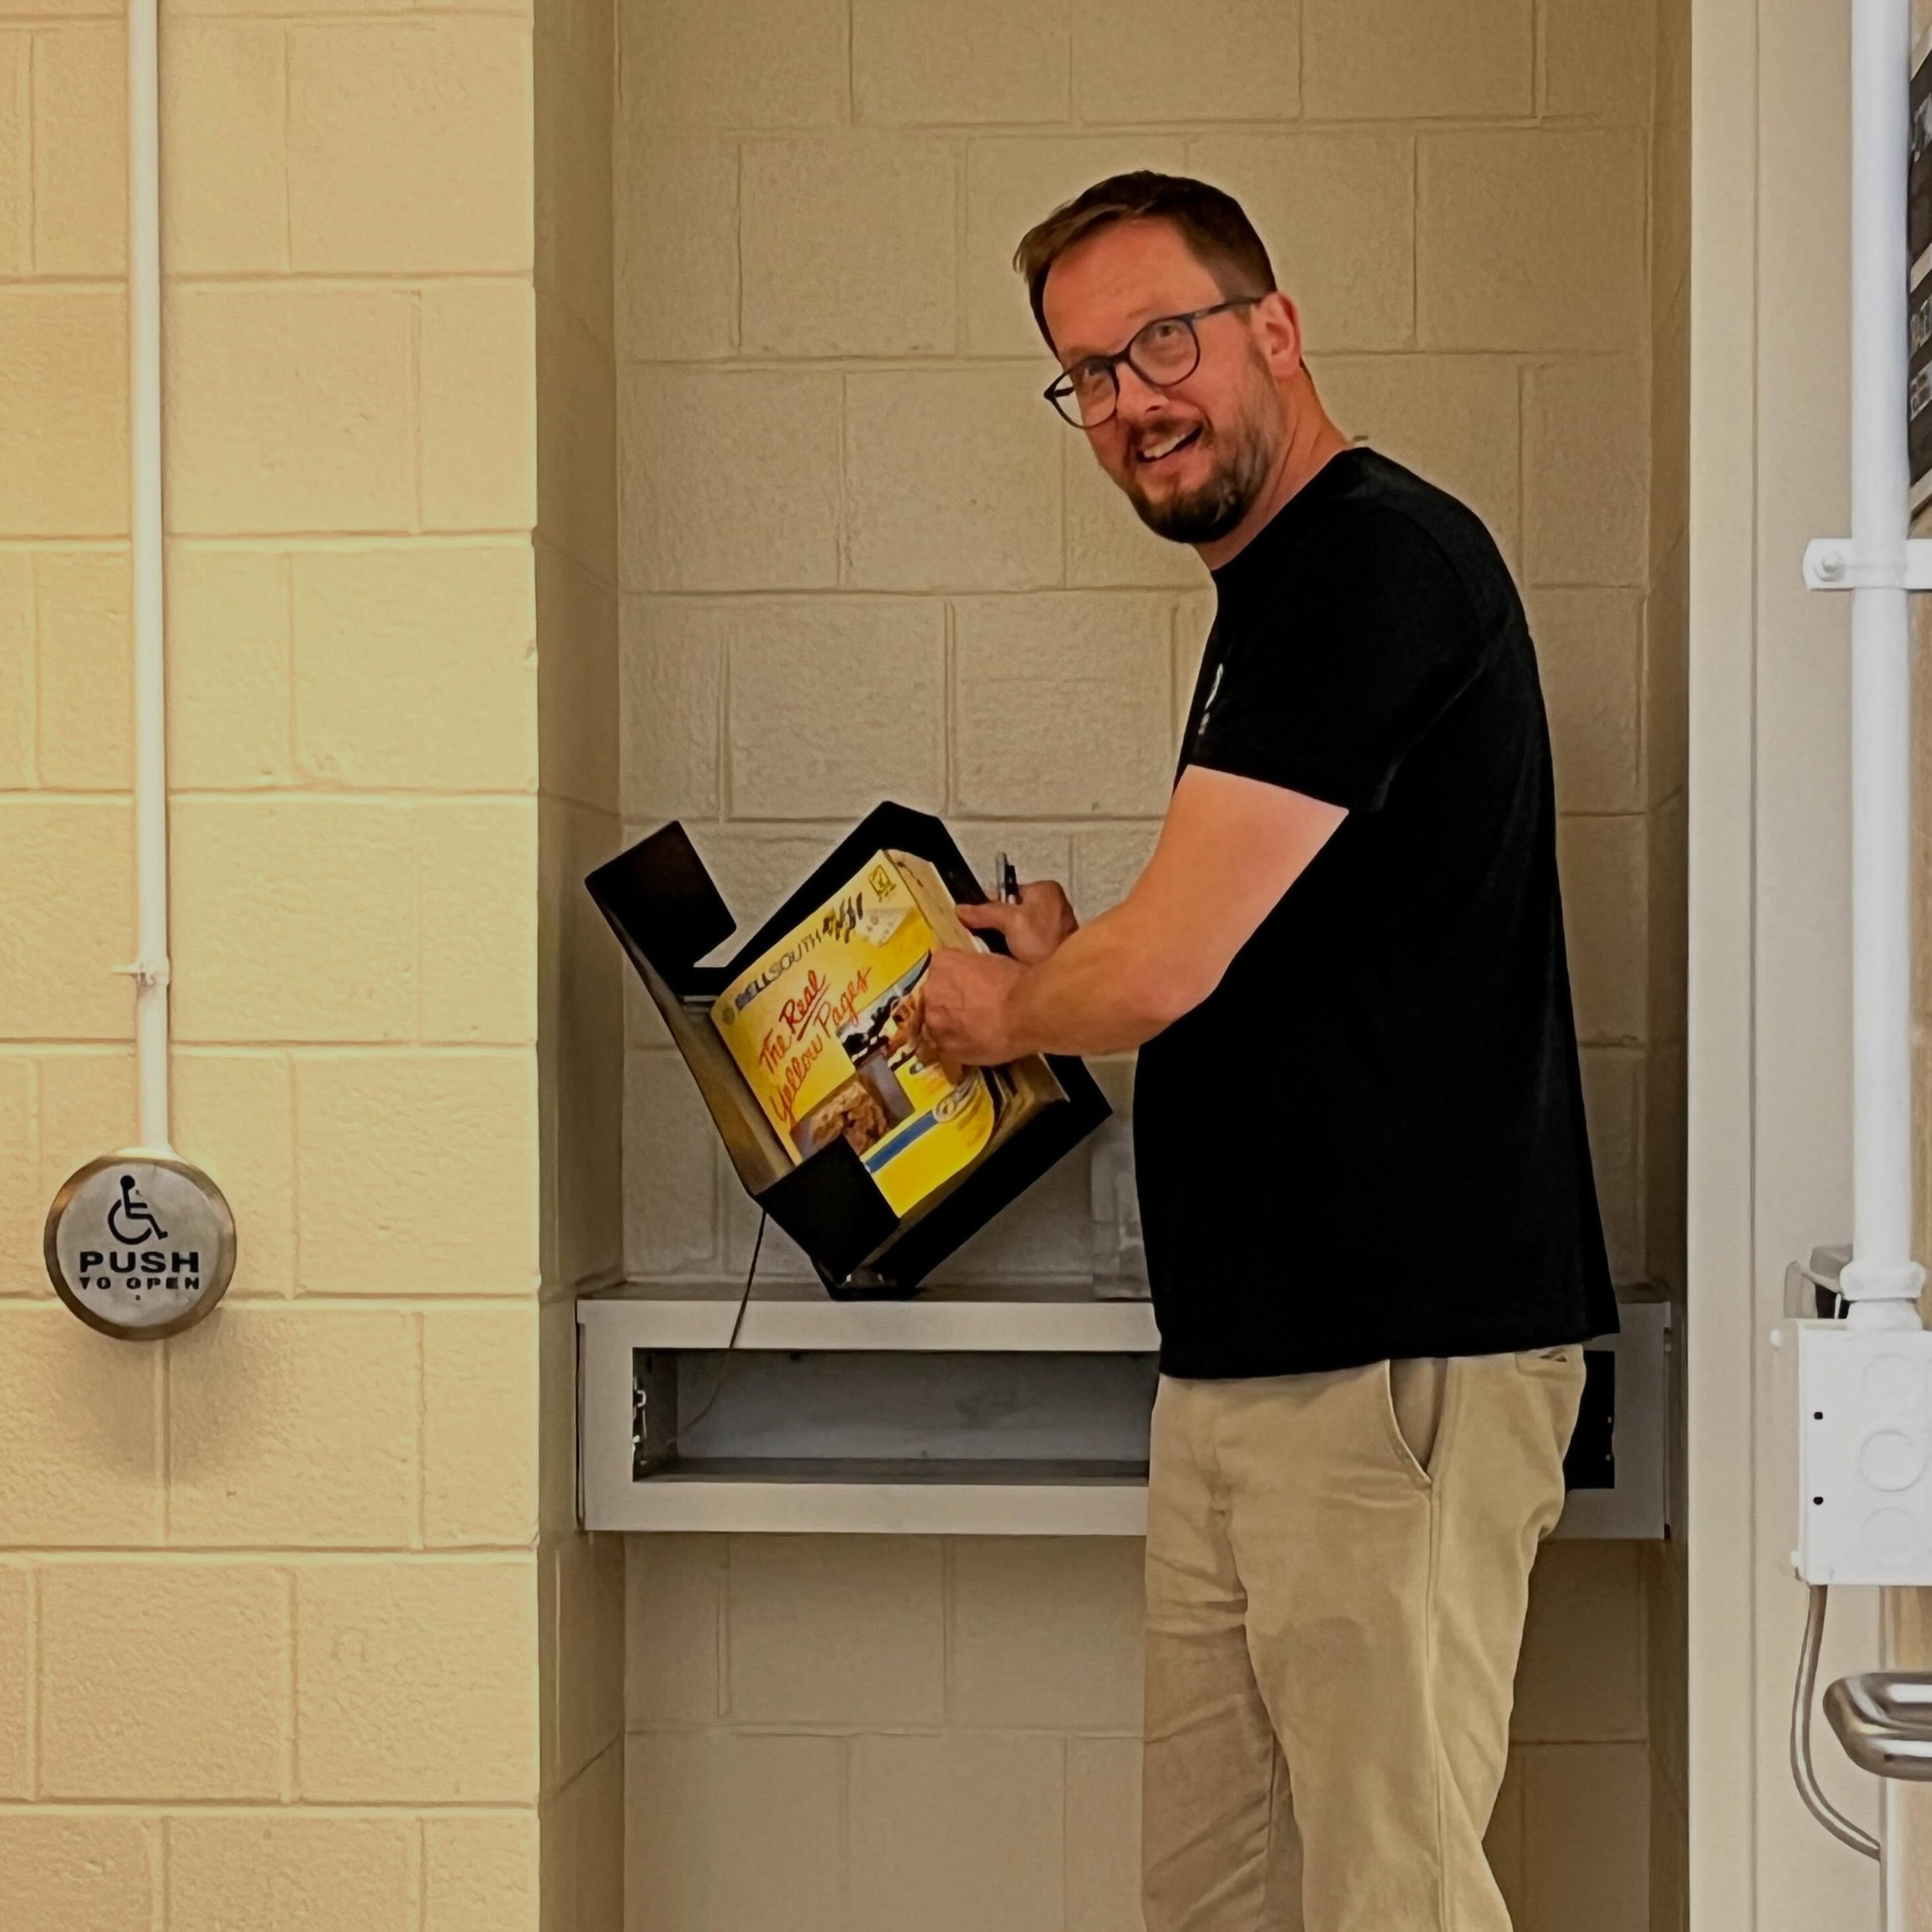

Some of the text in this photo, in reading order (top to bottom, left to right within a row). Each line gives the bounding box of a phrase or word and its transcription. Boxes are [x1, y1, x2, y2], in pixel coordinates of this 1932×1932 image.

[760, 969, 826, 1074] The Real
[769, 966, 872, 1126] Yellow Pages
[79, 1276, 199, 1290] TO OPEN
[80, 1251, 199, 1273] PUSH
